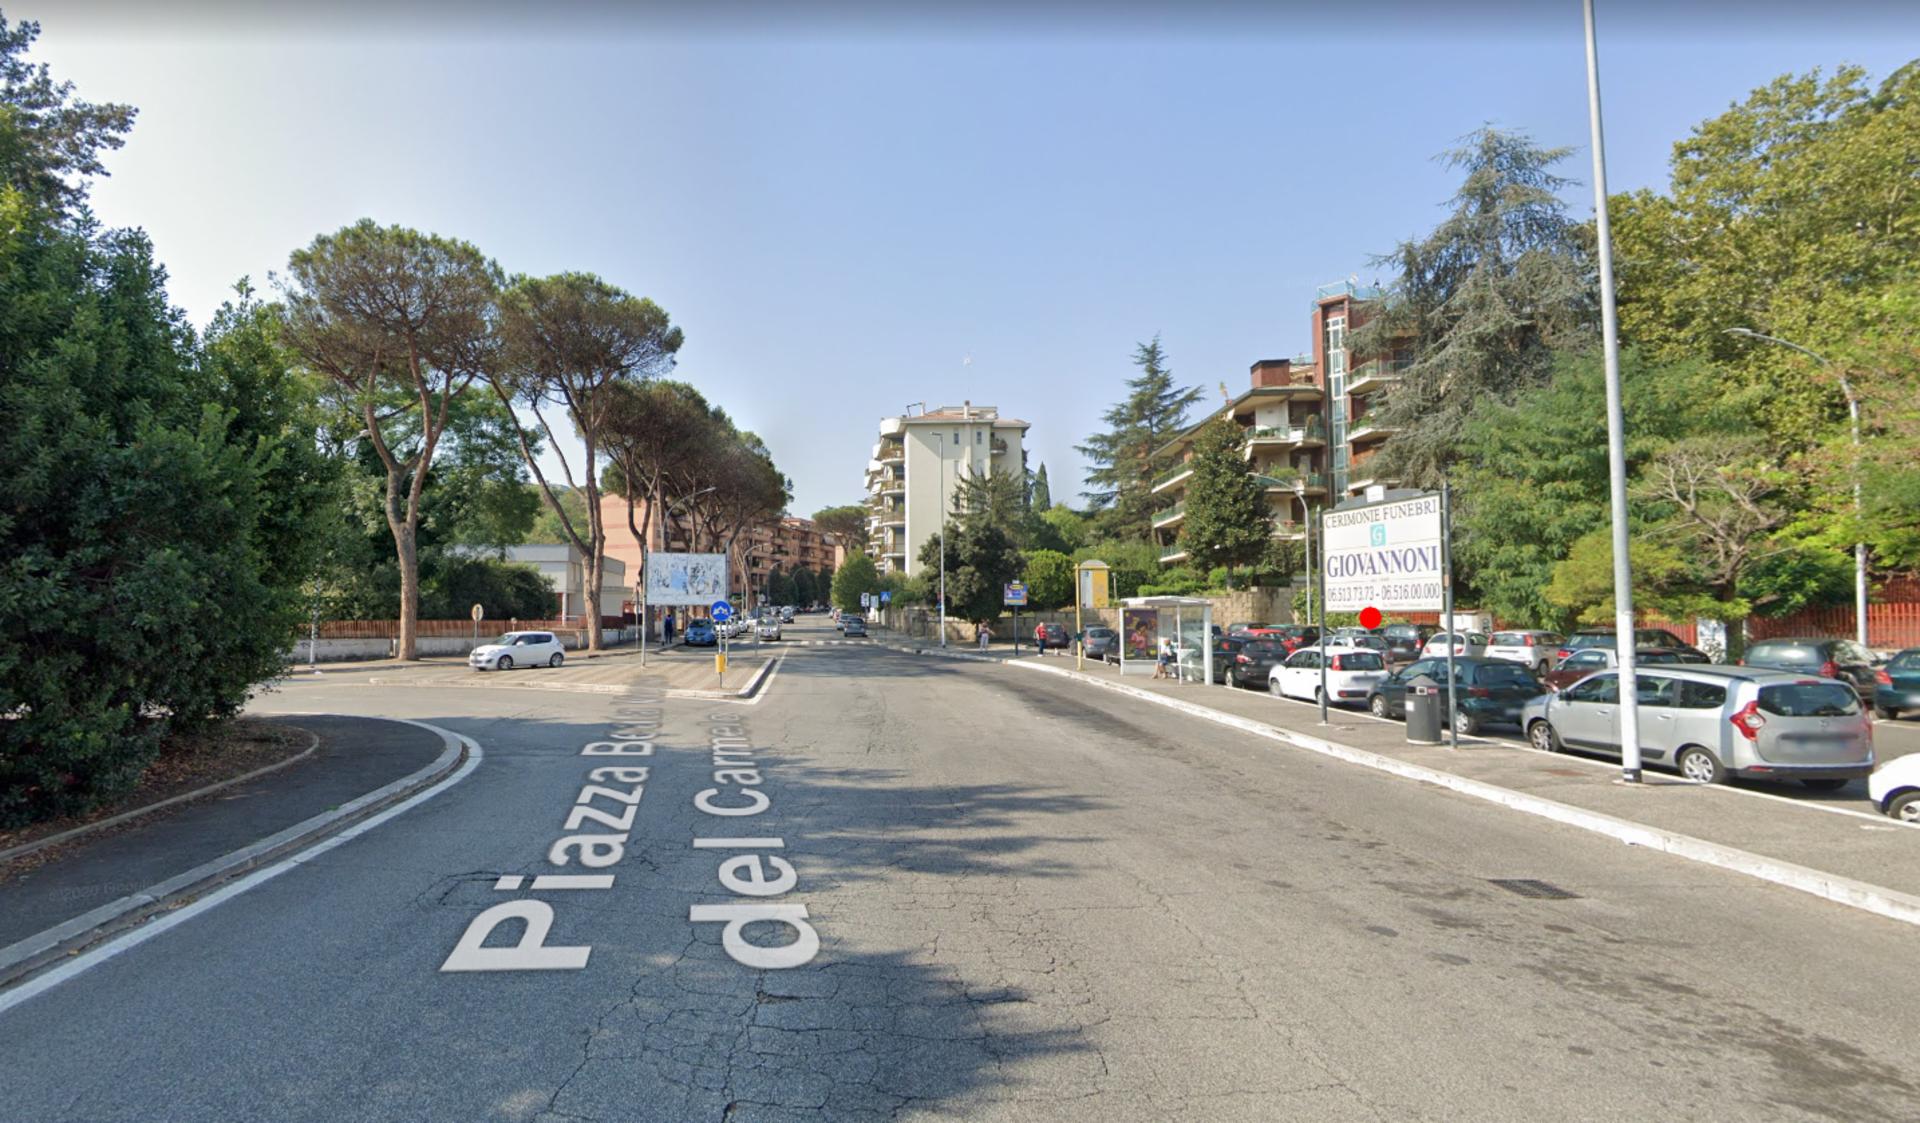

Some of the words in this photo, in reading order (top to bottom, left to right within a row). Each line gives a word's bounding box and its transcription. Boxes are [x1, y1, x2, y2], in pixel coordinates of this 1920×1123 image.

[1325, 508, 1380, 529] CERIMONIE
[1383, 499, 1436, 520] FUNEBRI
[1327, 546, 1438, 578] GIOVANNONI
